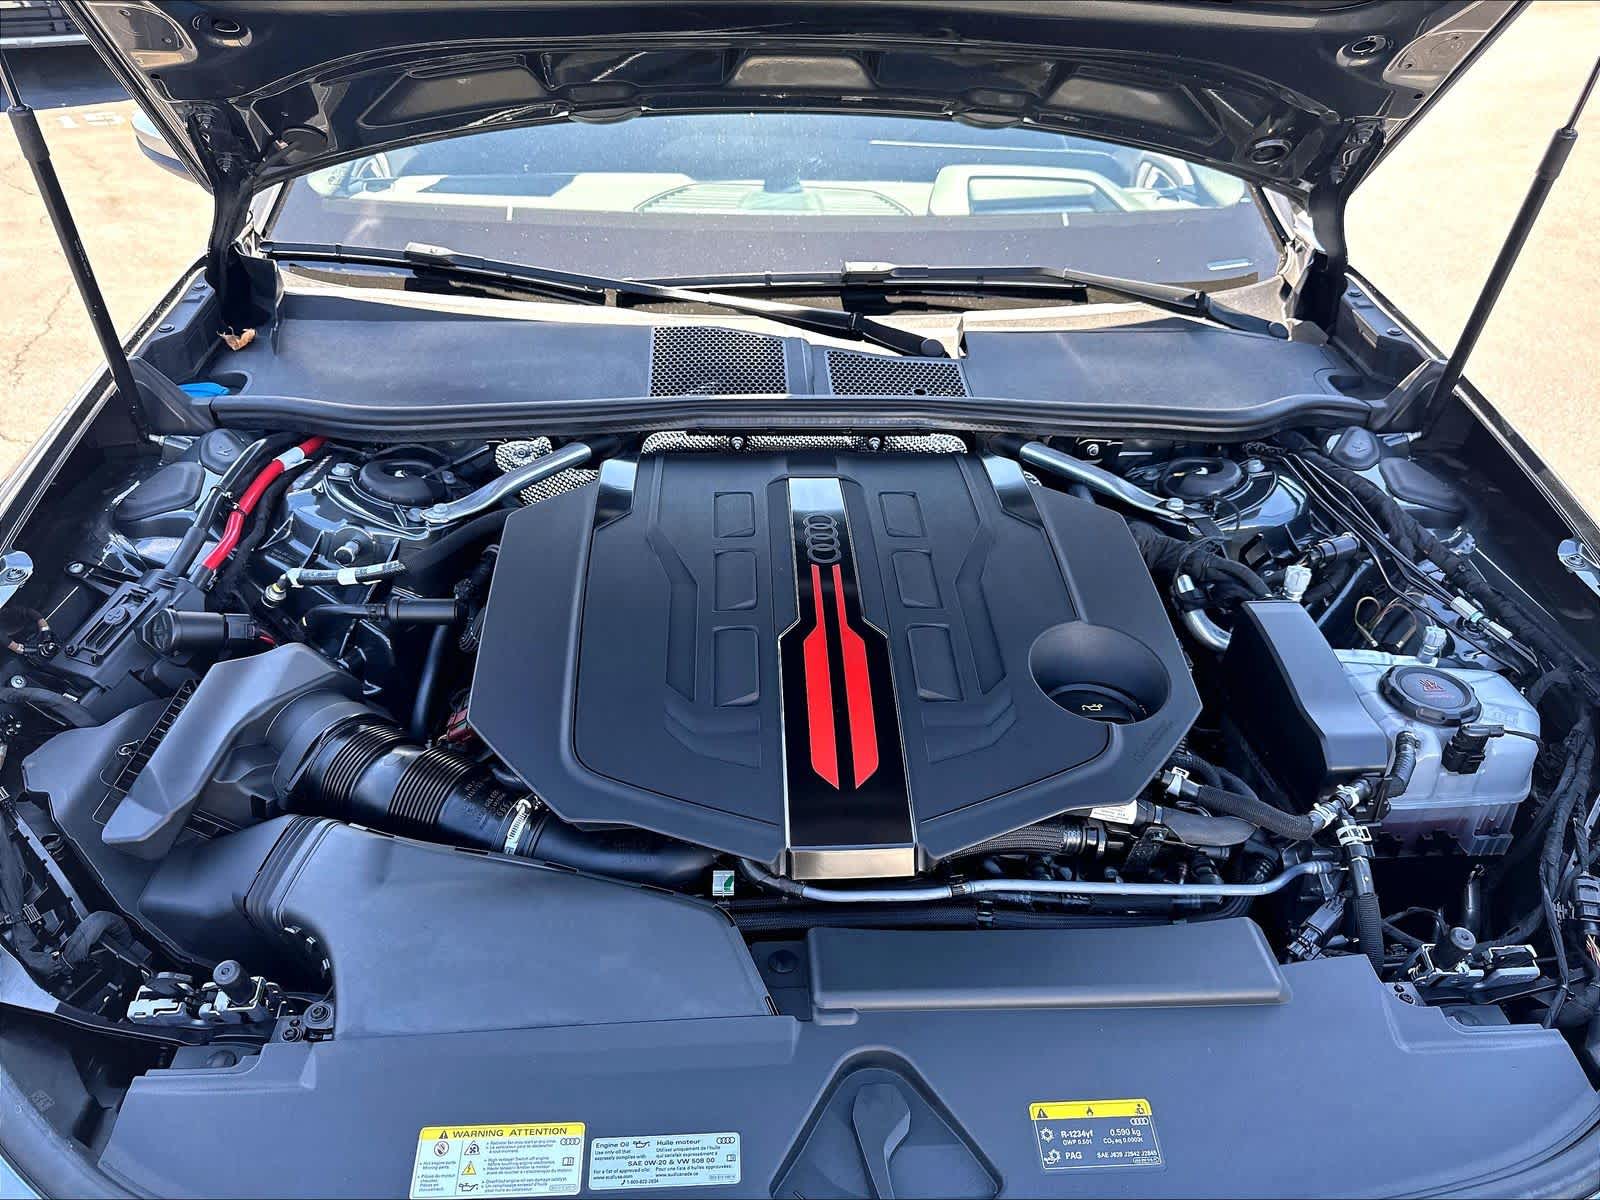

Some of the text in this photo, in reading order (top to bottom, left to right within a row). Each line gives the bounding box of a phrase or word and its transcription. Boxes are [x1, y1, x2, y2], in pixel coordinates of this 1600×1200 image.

[452, 1128, 568, 1138] WARNING ATTENTION
[1061, 1129, 1093, 1138] R-1234yf
[1131, 1128, 1141, 1136] kg
[1065, 1152, 1082, 1160] PAG
